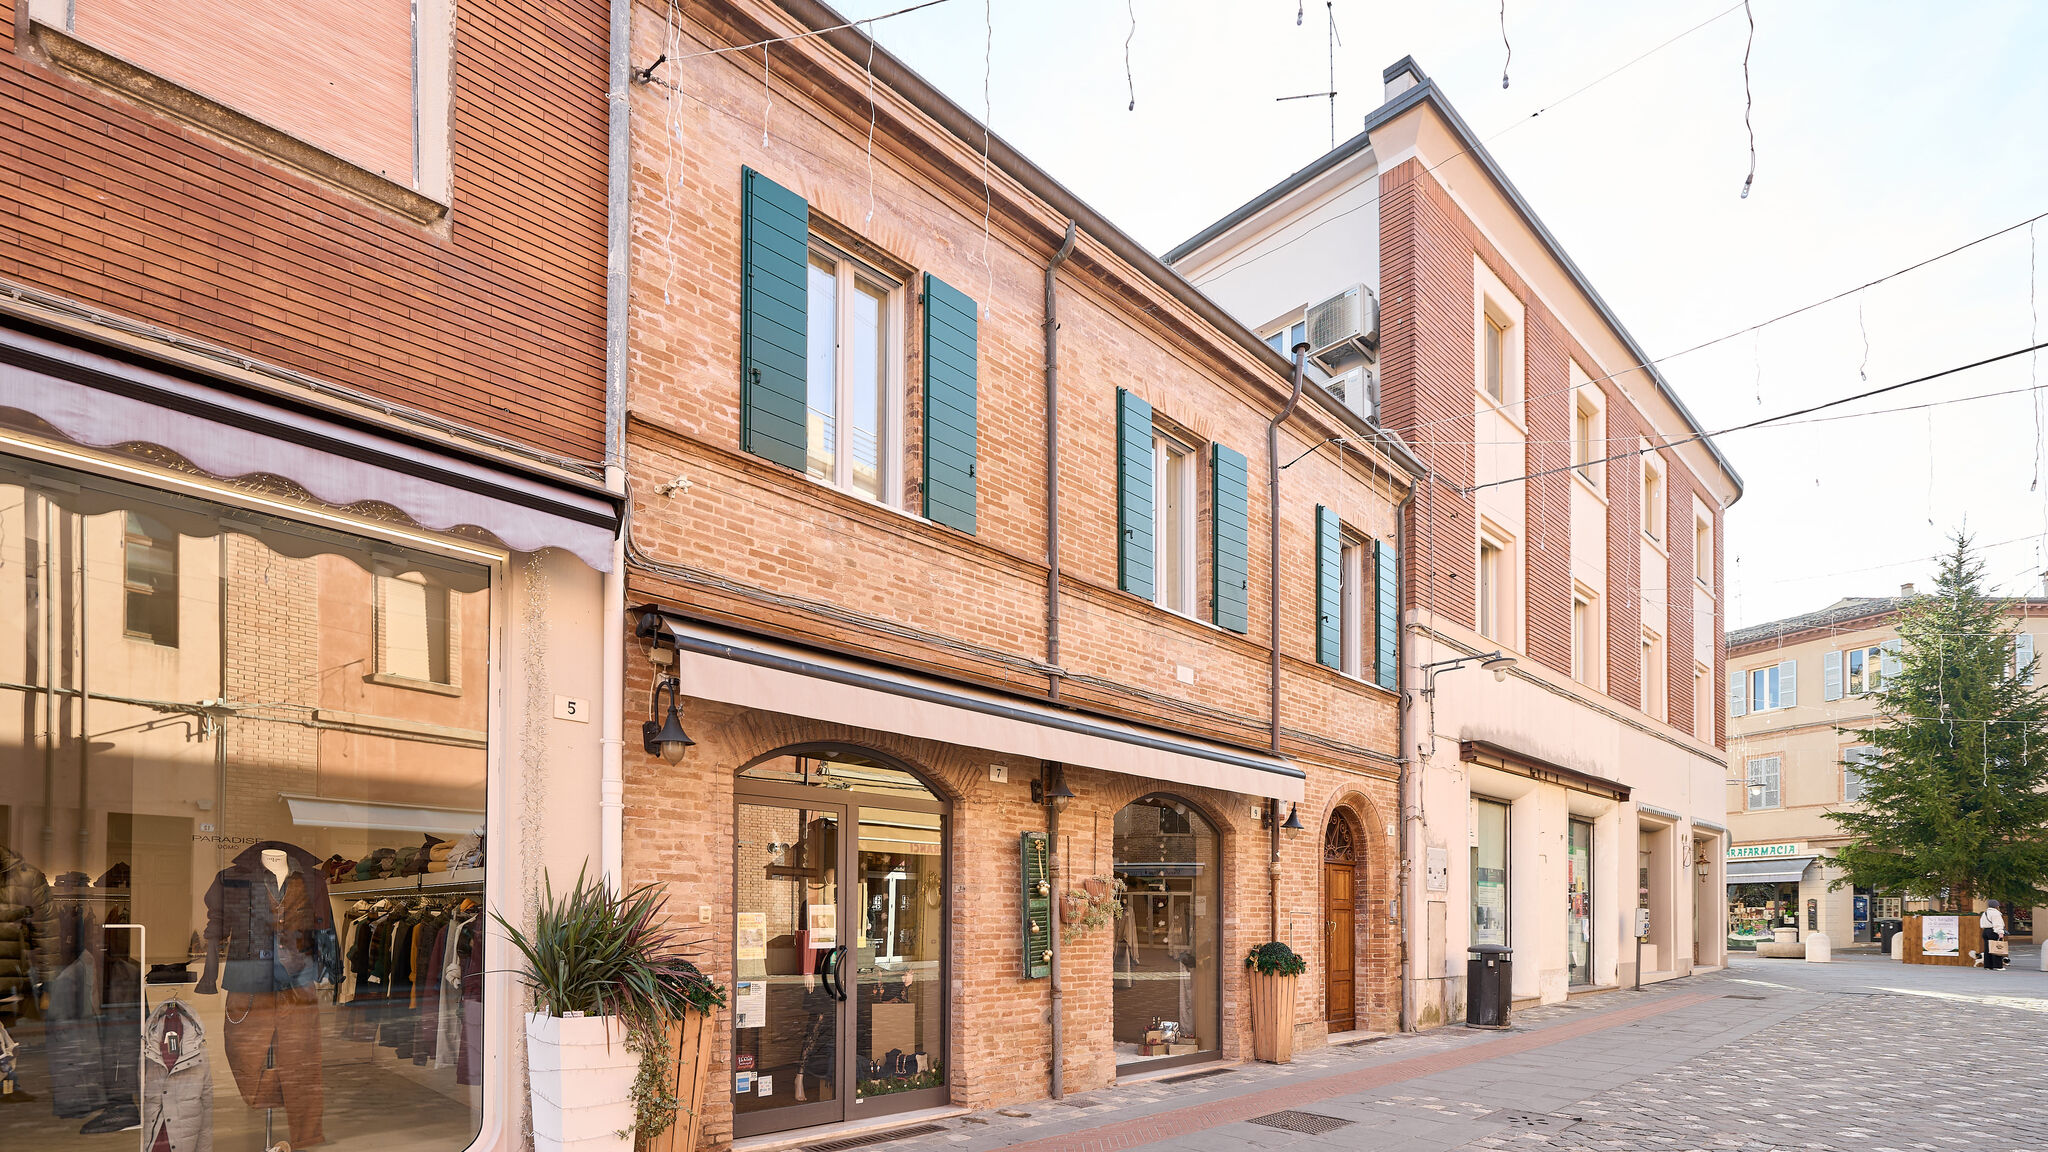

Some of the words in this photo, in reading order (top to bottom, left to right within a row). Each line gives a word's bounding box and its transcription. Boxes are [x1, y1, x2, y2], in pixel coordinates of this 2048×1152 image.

[567, 700, 576, 715] 5
[996, 768, 1002, 778] 7
[1727, 845, 1795, 857] ARAFARMACIA
